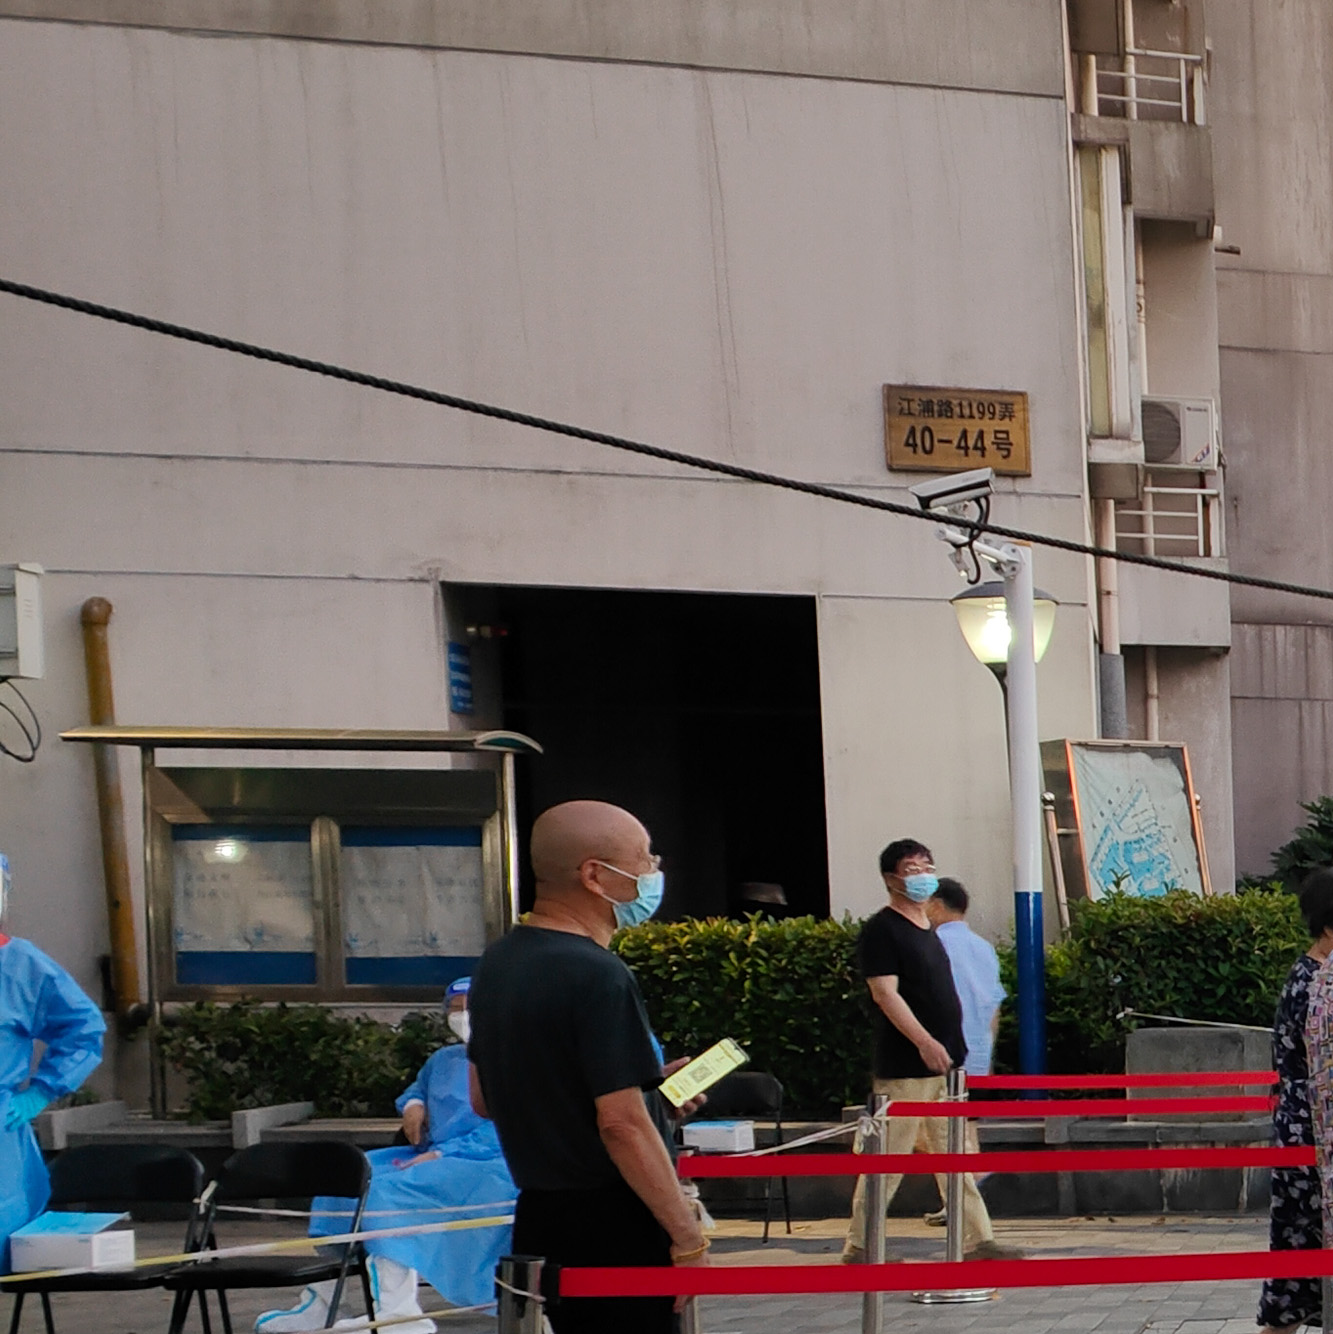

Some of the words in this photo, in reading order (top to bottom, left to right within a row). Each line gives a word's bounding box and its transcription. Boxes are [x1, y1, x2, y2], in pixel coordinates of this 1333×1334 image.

[898, 396, 1016, 422] 江浦路1199弄
[904, 425, 1014, 460] 40-44号
